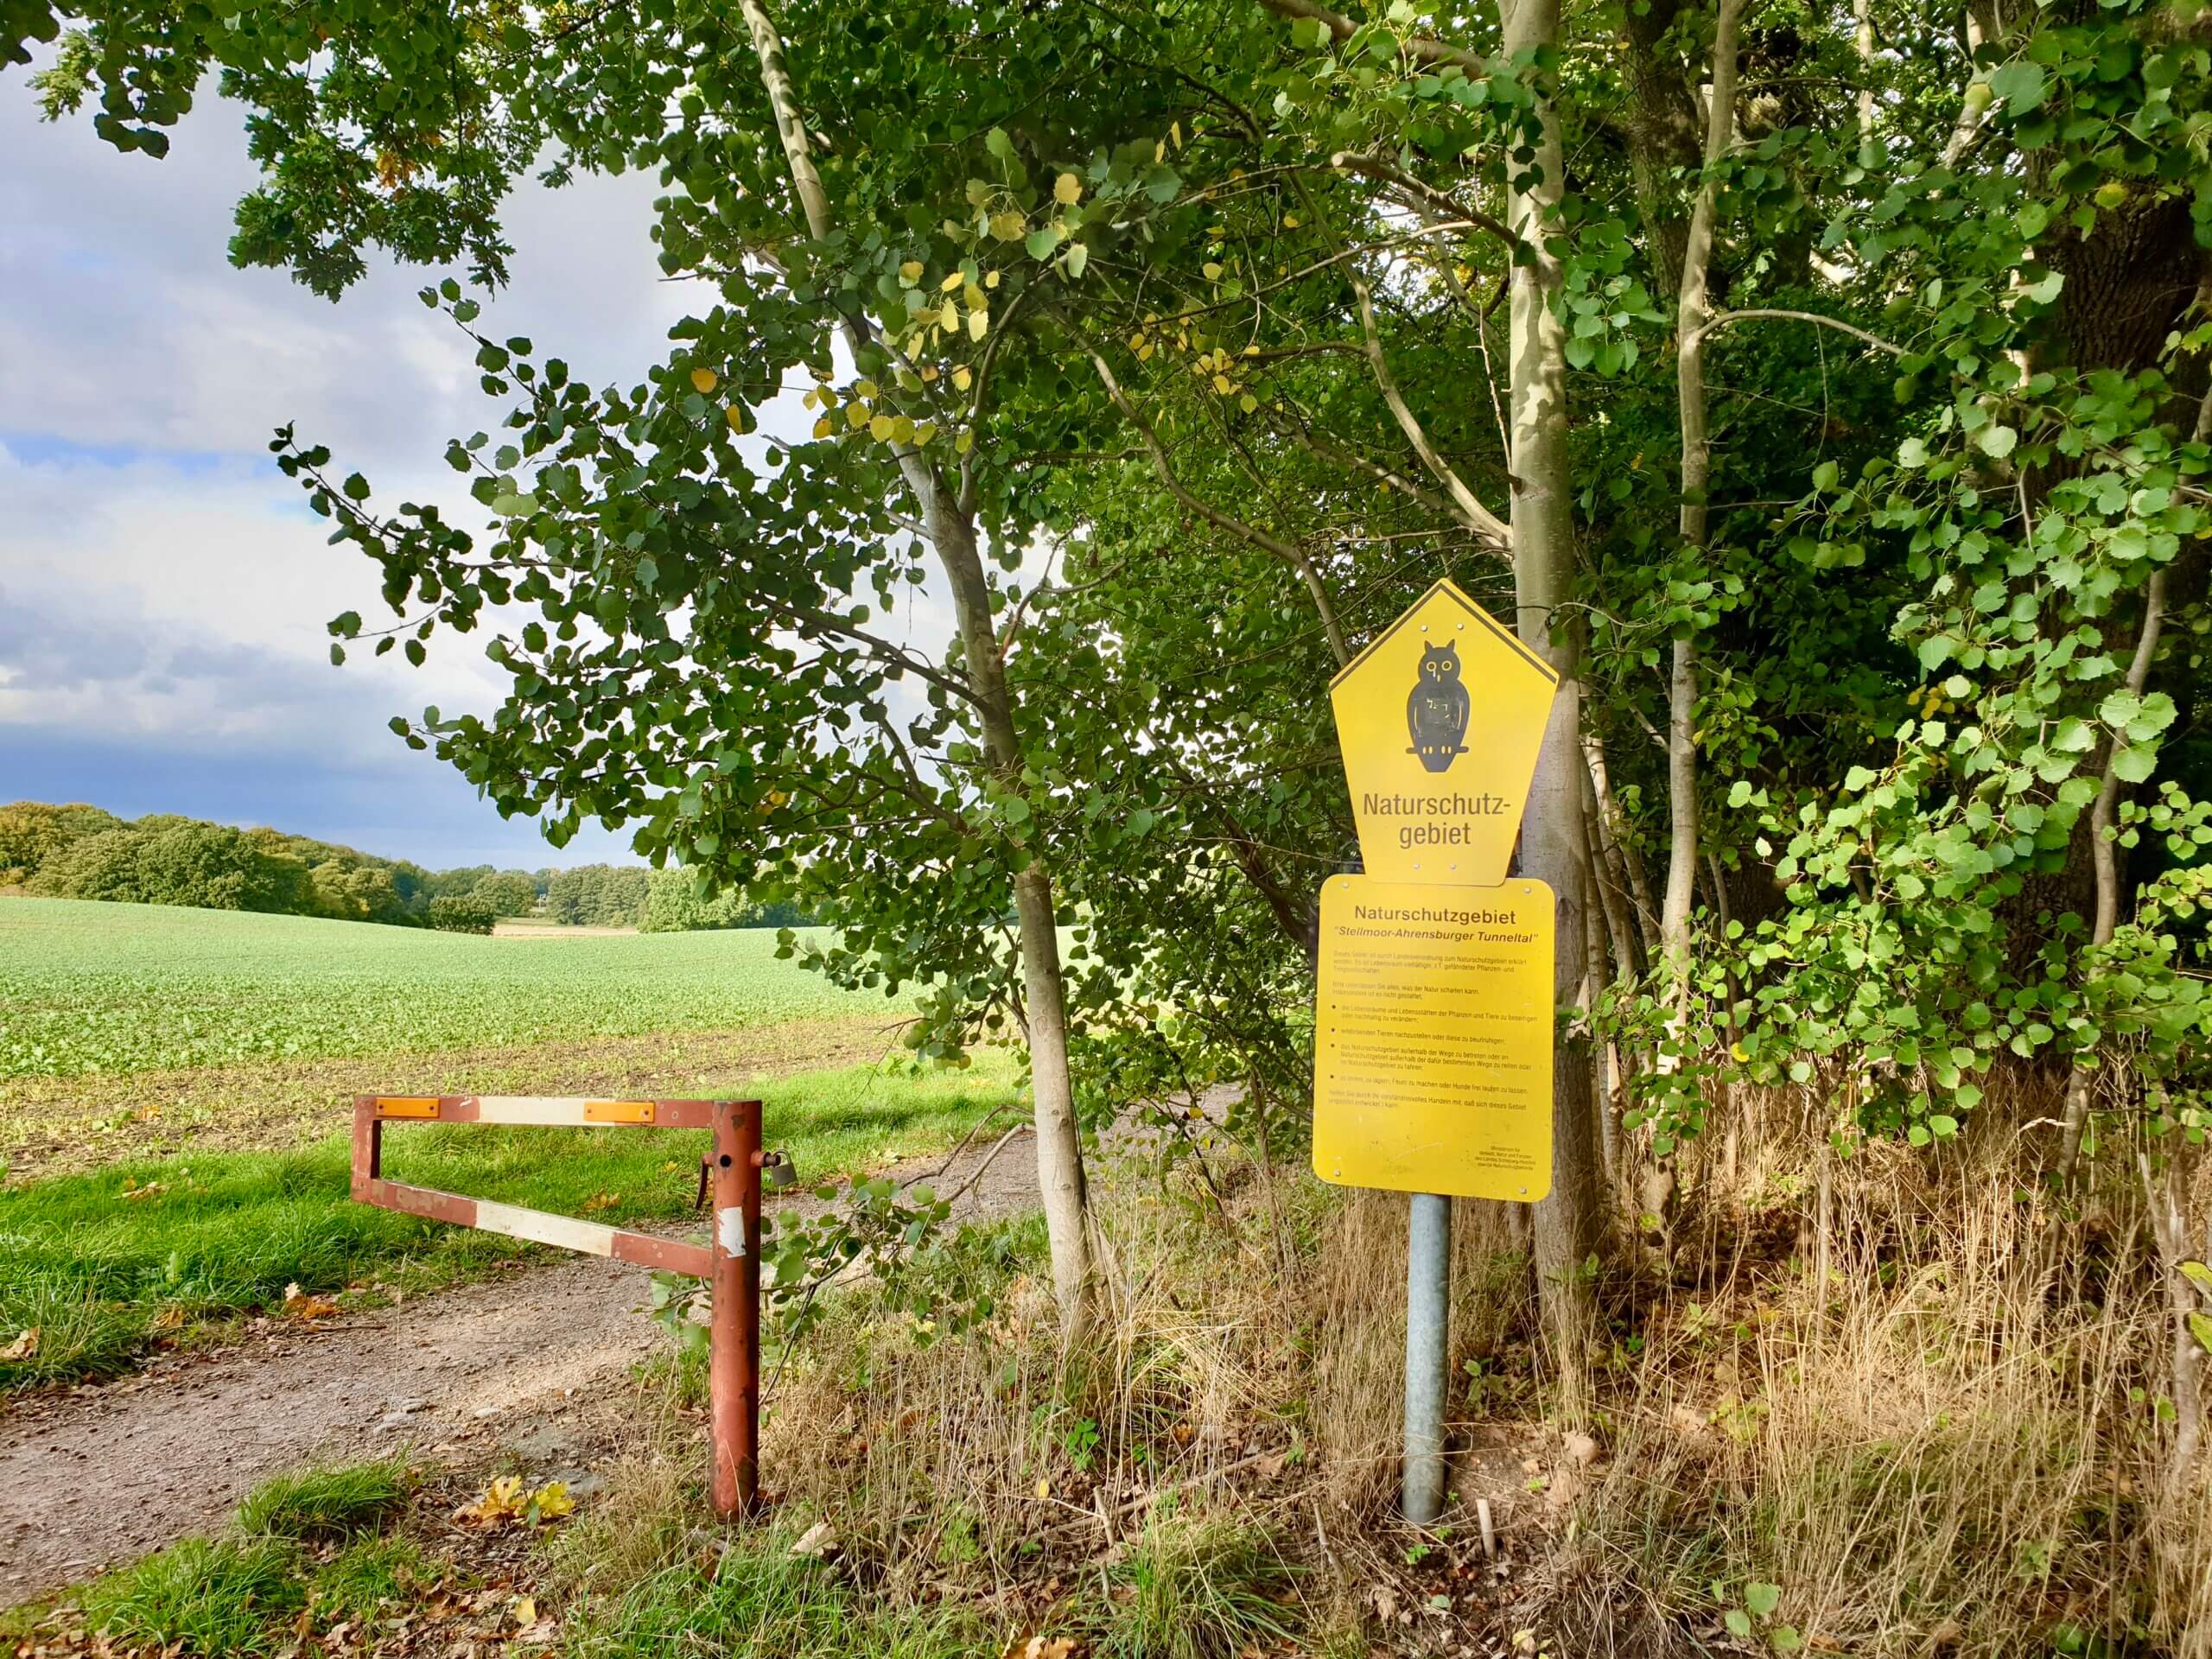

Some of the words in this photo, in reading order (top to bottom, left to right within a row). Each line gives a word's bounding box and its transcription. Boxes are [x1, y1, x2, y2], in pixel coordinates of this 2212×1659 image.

[1363, 793, 1510, 816] Naturschutz-
[1400, 823, 1471, 849] gebiet
[1355, 906, 1516, 925] Naturschutzgebiet
[1457, 955, 1507, 965] Naturschutzgebiet
[1485, 1012, 1500, 1020] Tiere
[1376, 1029, 1394, 1038] Tieren
[1438, 1050, 1454, 1058] Wege
[1416, 1080, 1438, 1089] machen
[1452, 1082, 1471, 1091] Hunde
[1476, 1100, 1488, 1109] sich
